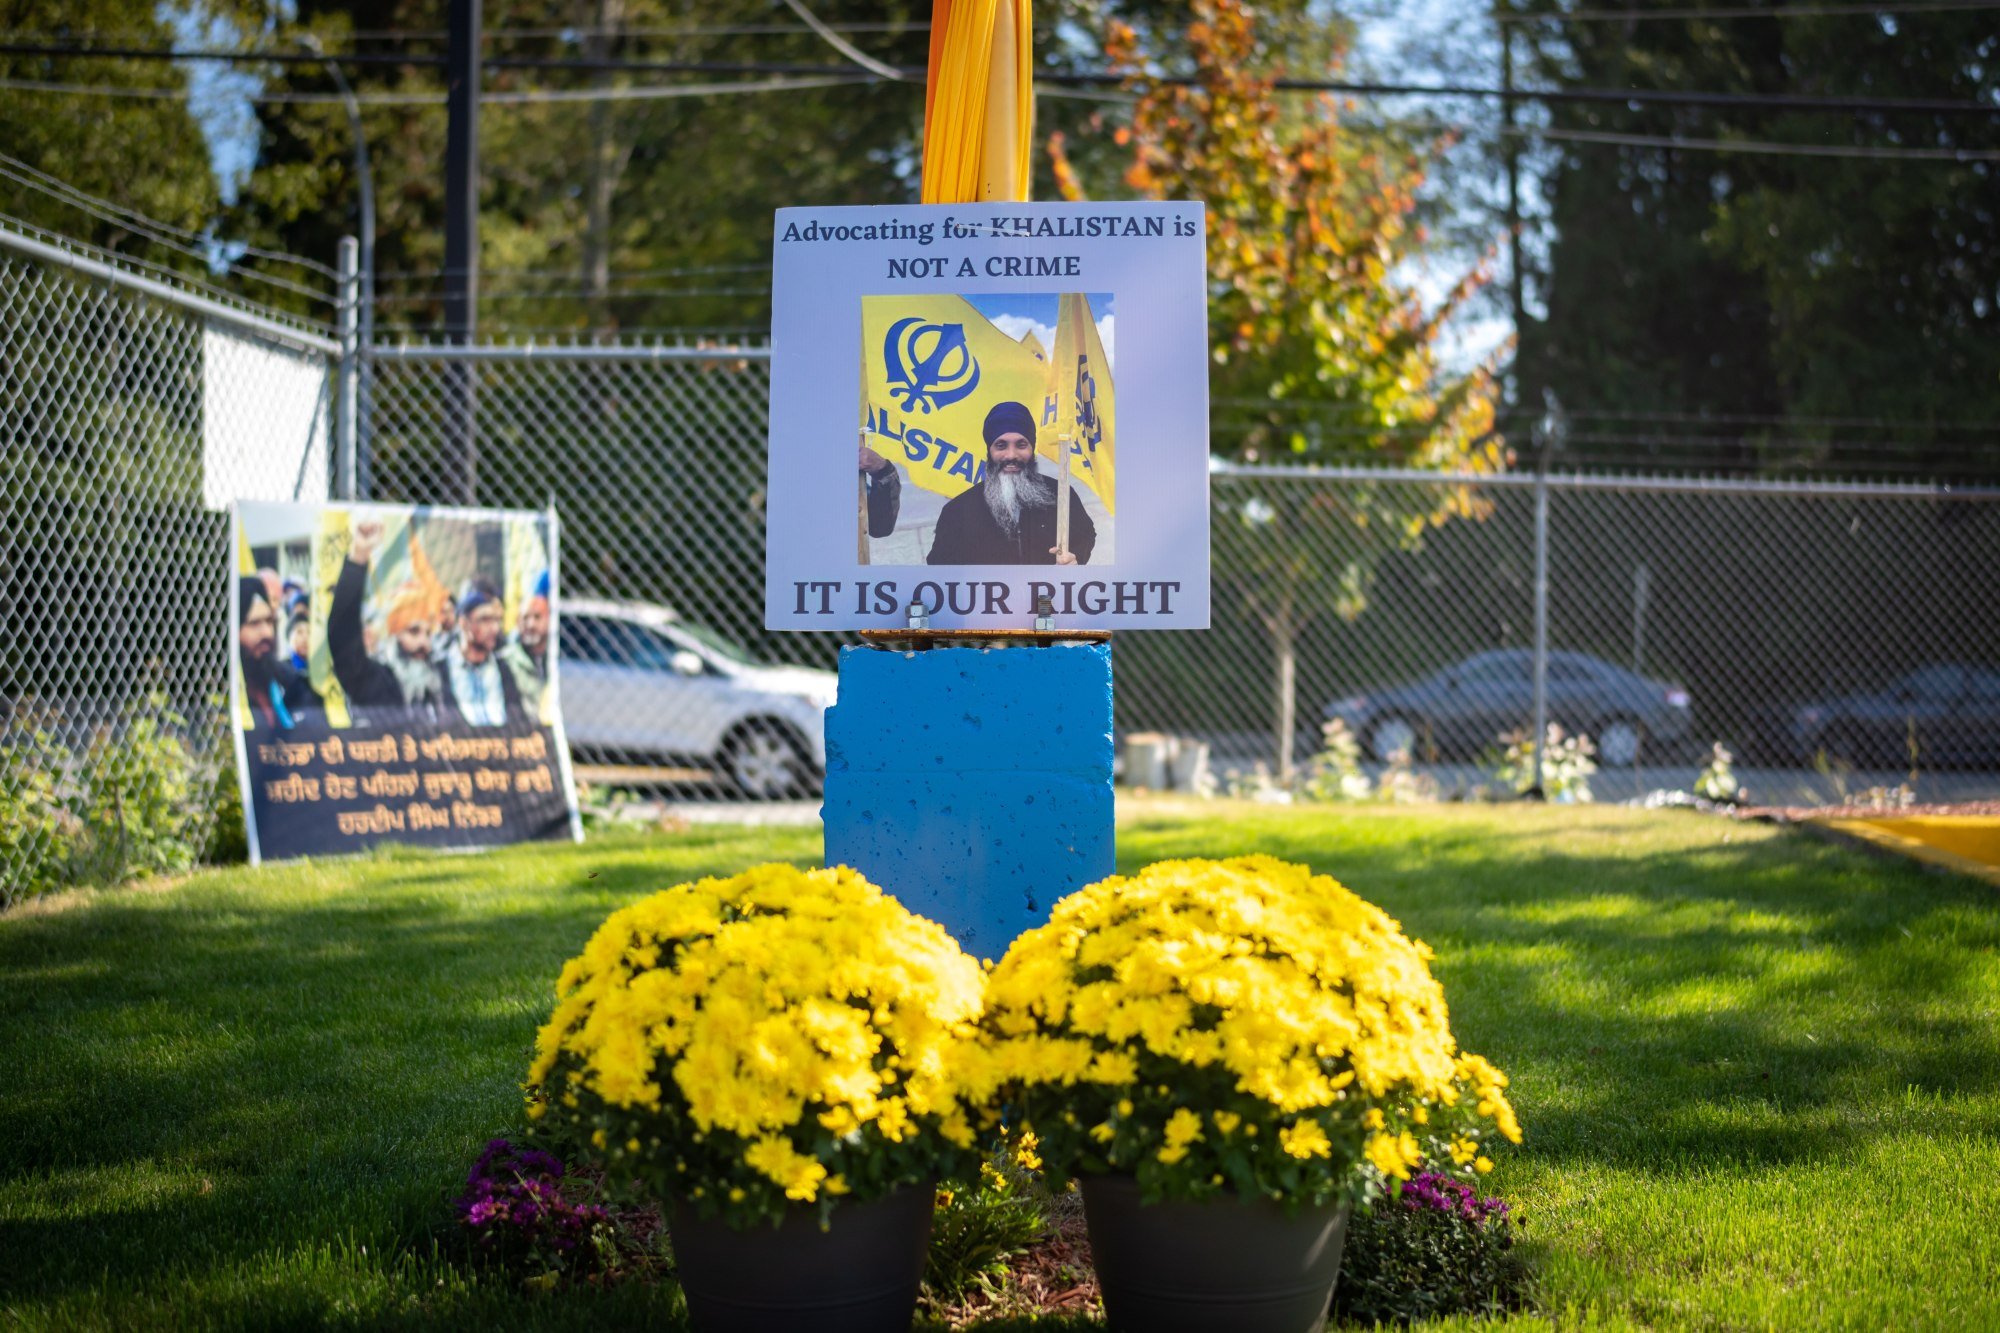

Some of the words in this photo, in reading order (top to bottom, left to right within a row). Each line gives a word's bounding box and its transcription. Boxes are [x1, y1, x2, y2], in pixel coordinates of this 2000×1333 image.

[781, 219, 934, 246] Advocating
[943, 216, 978, 239] for
[990, 215, 1165, 239] KHALISTAN
[1174, 216, 1196, 237] is
[887, 257, 948, 279] NOT
[956, 257, 978, 278] A
[985, 256, 1081, 278] CRIME
[793, 581, 841, 615] IT
[854, 581, 897, 615] IS
[912, 581, 1013, 616] OUR
[1027, 580, 1181, 615] RIGHT
